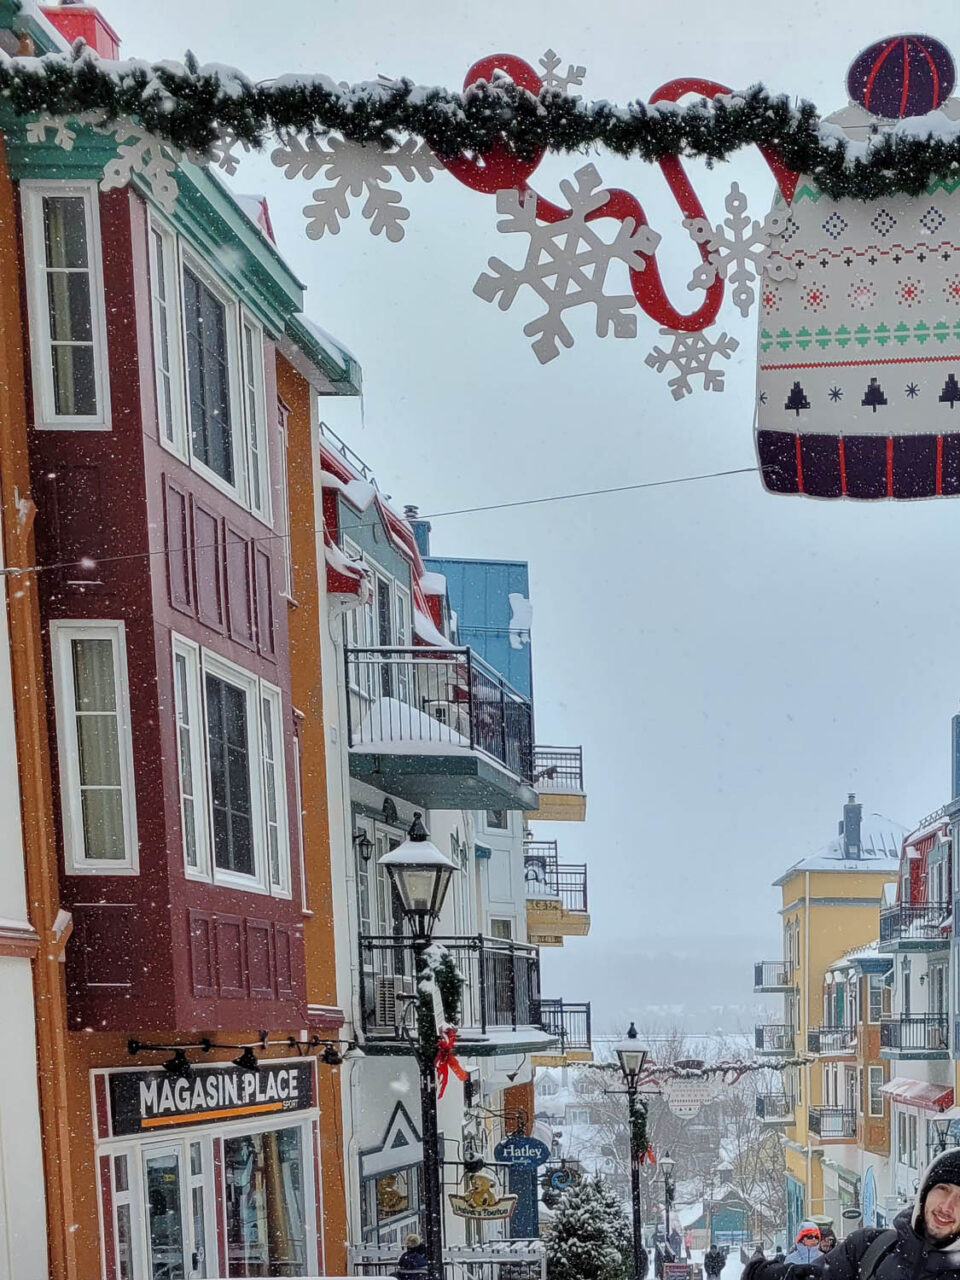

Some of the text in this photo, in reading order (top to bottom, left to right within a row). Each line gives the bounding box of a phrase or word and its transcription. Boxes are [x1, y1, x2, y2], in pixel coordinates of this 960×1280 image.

[139, 1074, 239, 1115] MAGASIN
[245, 1069, 299, 1103] PLACE
[282, 1099, 299, 1110] SPORT
[503, 1144, 542, 1160] Hatley
